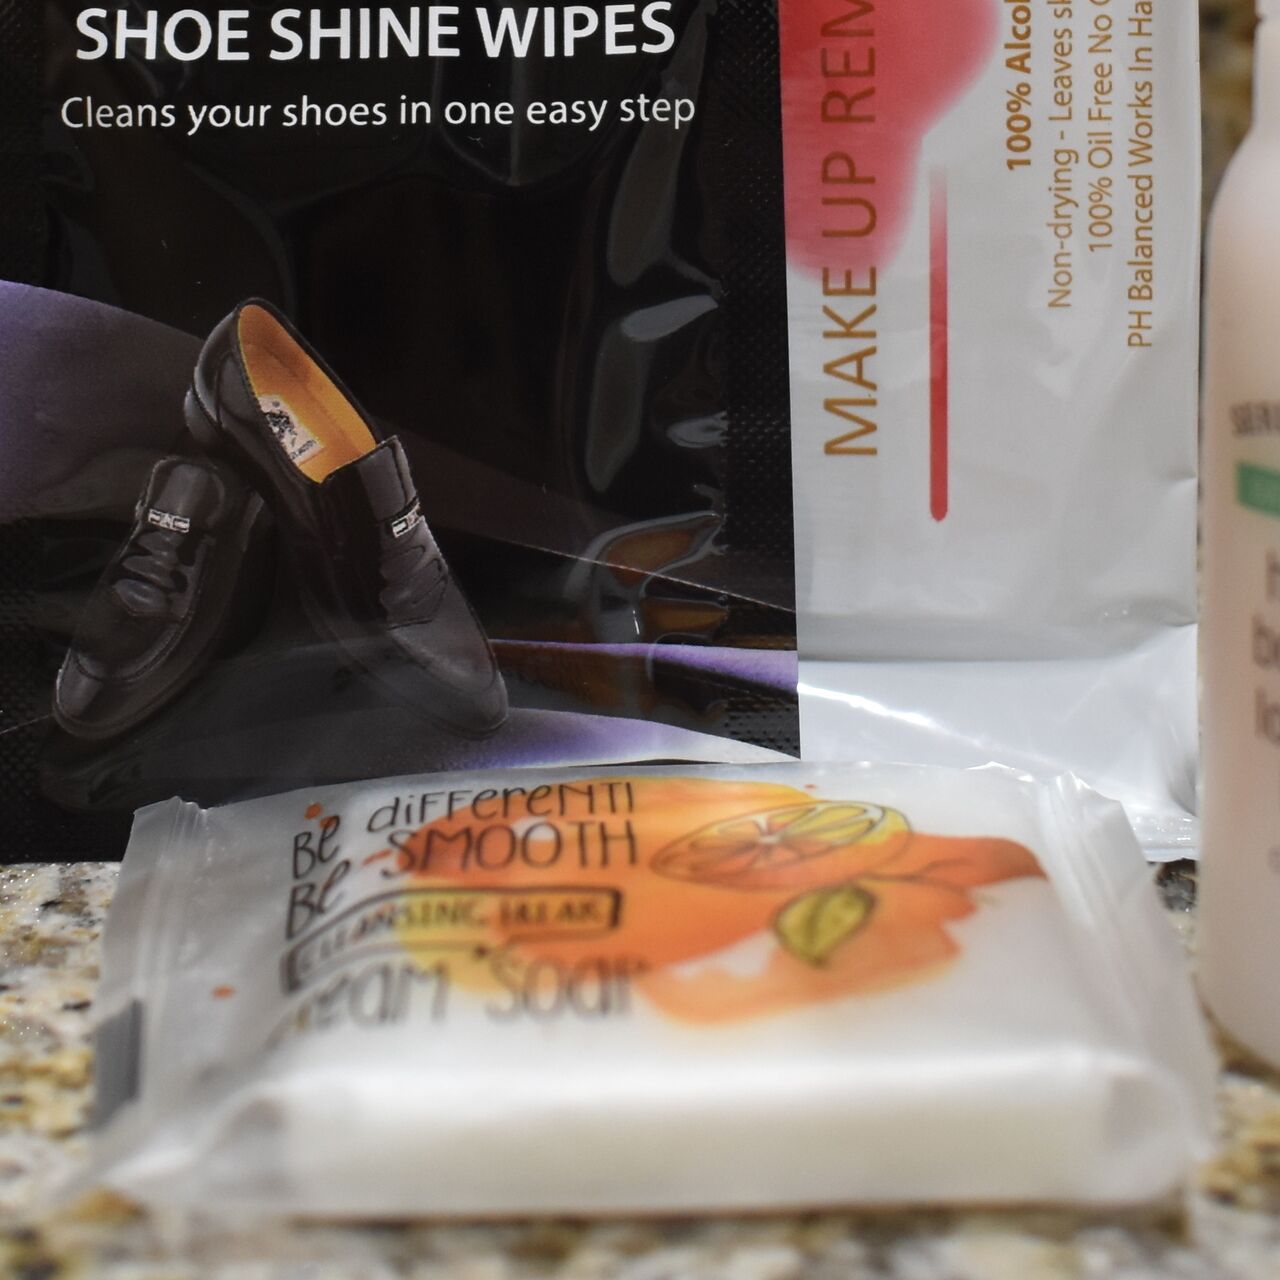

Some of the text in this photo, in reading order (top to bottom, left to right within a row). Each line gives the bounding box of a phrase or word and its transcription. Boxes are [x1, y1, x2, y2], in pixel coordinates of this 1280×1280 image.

[76, 1, 675, 62] SHOE SHINE WIPES
[1087, 12, 1113, 53] No
[1128, 45, 1153, 71] In
[1047, 26, 1073, 120] Leaves
[1087, 61, 1113, 121] Free
[61, 93, 695, 136] Cleans your shoes in one easy step
[1006, 81, 1032, 170] 100%
[1127, 79, 1154, 166] Works
[1087, 130, 1113, 168] Oil
[819, 149, 878, 239] UP
[1046, 147, 1080, 307] Non-drying
[1087, 175, 1113, 251] 100%
[1127, 173, 1153, 300] Balanced
[821, 264, 879, 457] MAKE
[1127, 309, 1153, 347] PH
[381, 820, 638, 878] SMOOTH
